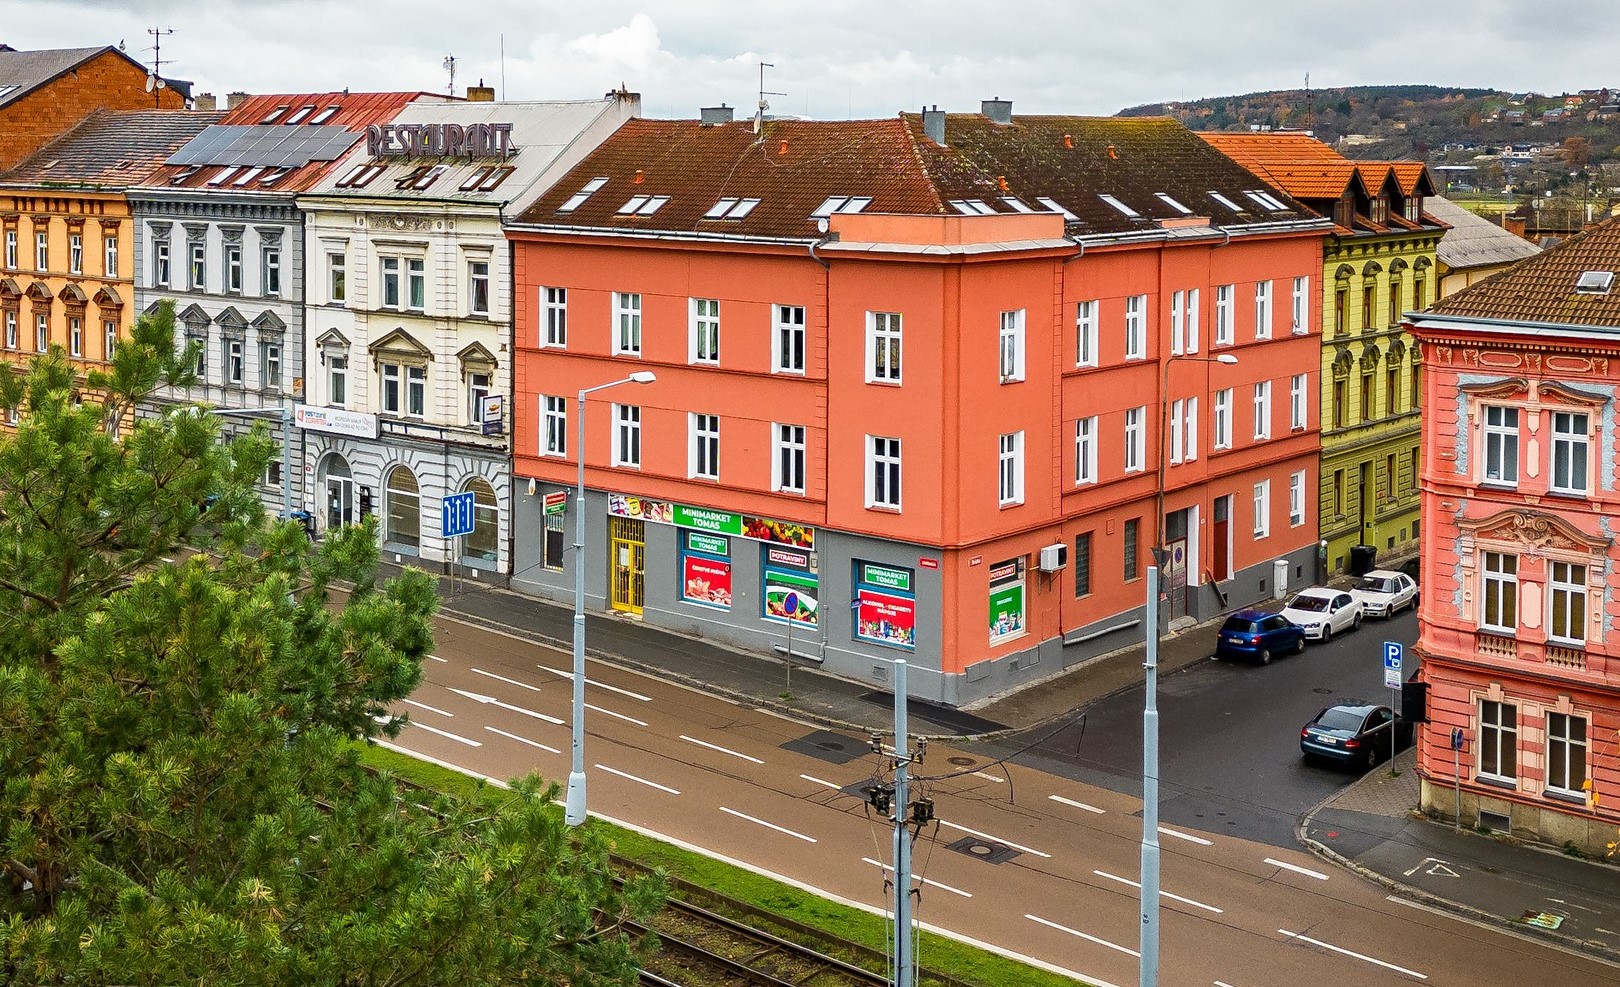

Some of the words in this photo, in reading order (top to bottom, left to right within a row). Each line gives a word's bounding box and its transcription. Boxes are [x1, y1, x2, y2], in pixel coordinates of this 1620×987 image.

[367, 123, 513, 156] RESTAURANT
[682, 508, 731, 523] MINIMARKET
[693, 518, 720, 530] TOMAS
[691, 535, 725, 547] MINIMARKET
[699, 543, 717, 551] TOMAS
[772, 553, 804, 563] POTRAVINY
[867, 568, 907, 581] MINIMARKET
[876, 576, 898, 586] TOMAS
[1389, 646, 1399, 660] P
